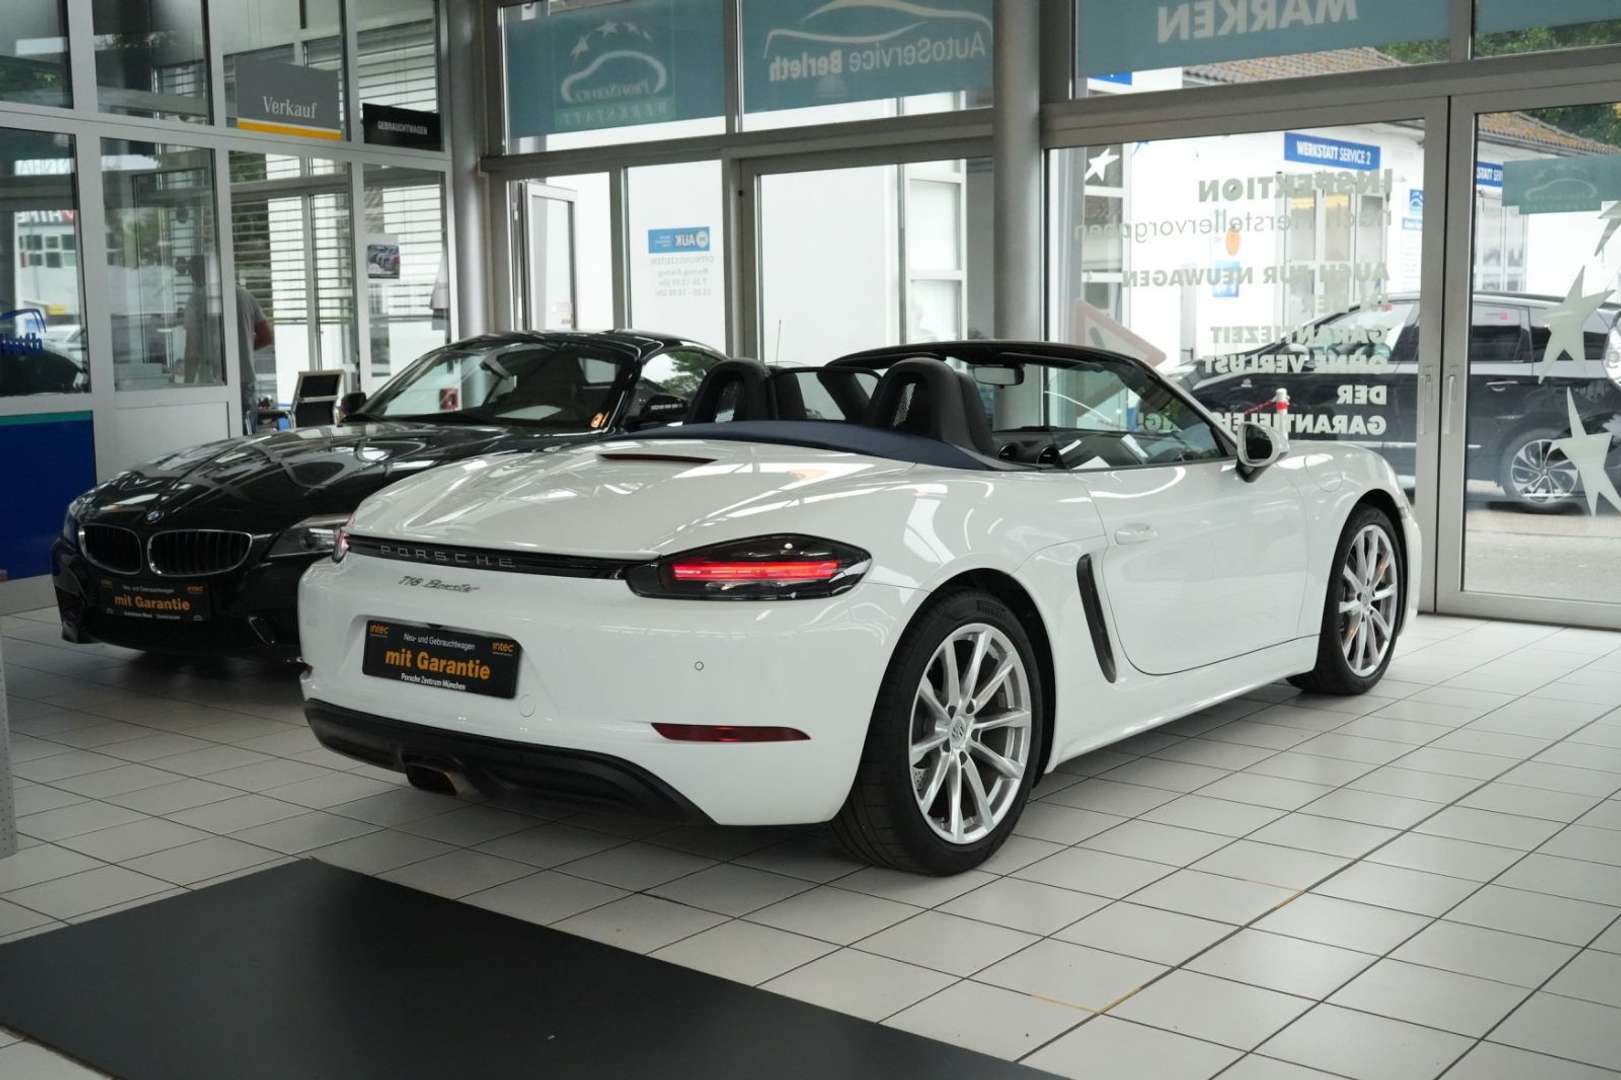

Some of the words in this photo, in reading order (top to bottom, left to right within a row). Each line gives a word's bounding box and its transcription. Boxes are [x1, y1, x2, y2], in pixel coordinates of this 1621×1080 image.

[263, 95, 318, 119] Verkauf
[377, 121, 428, 135] GEBRAUCHTWAGEN
[1297, 141, 1338, 160] WERKSTATT
[1339, 147, 1366, 164] SERVICE
[380, 545, 516, 568] PORSCHE
[114, 594, 132, 608] mit
[135, 595, 190, 611] Garantie
[403, 633, 417, 643] Neu-
[417, 635, 430, 646] und
[429, 636, 476, 652] Gebrauchtwagen
[492, 641, 514, 653] intec
[385, 648, 413, 667] mit
[417, 651, 491, 680] Garantie
[401, 672, 421, 683] Porsche
[421, 675, 442, 687] Zentrum
